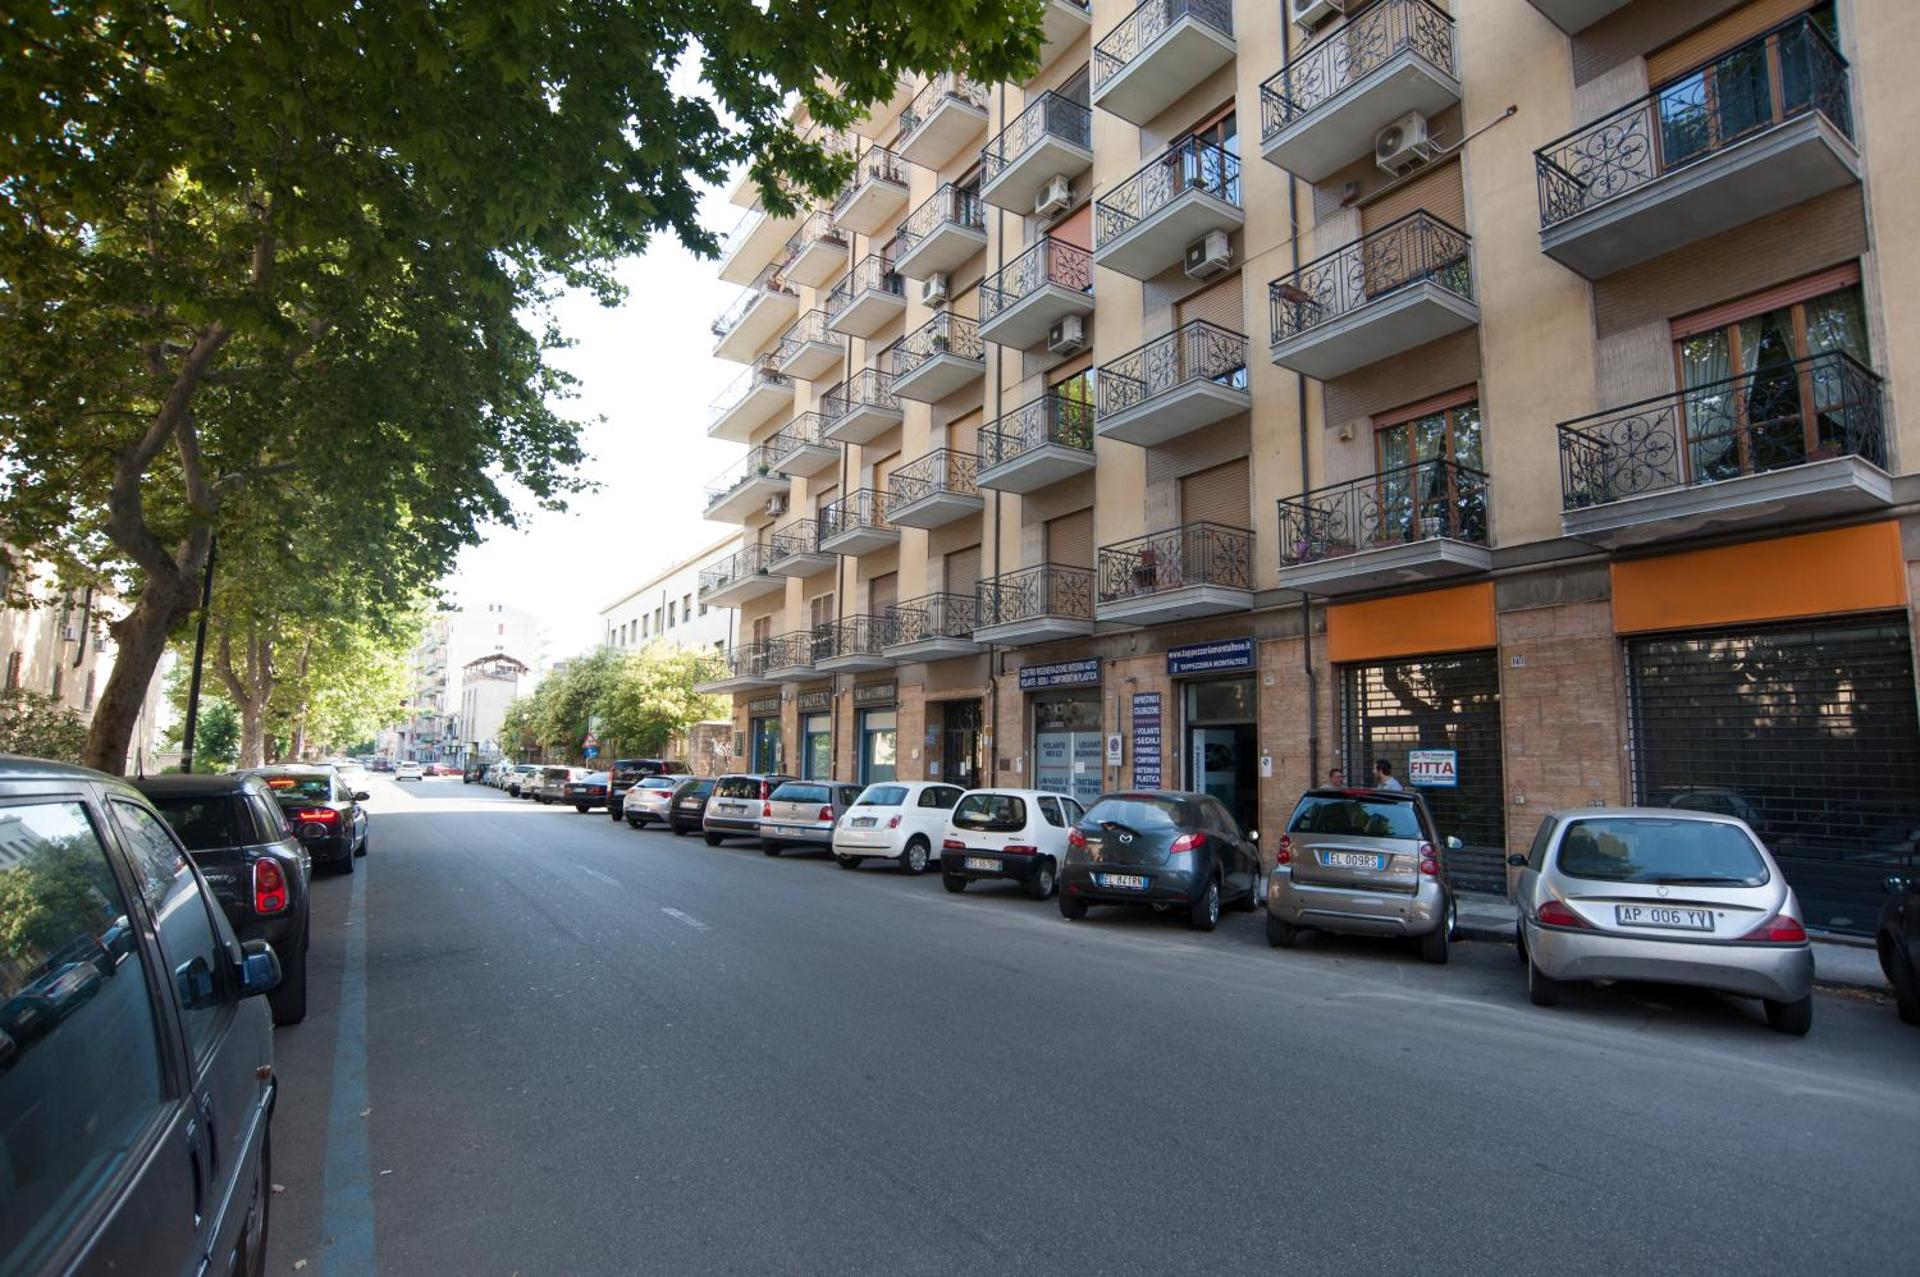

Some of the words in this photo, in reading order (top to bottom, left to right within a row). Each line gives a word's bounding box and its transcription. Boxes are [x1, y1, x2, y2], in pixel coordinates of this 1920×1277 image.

[1411, 762, 1454, 774] FITTA
[1331, 853, 1342, 865] EL
[1346, 855, 1377, 867] 009RS
[1624, 907, 1641, 921] AP
[1651, 909, 1680, 923] 006
[1687, 911, 1706, 928] YY
